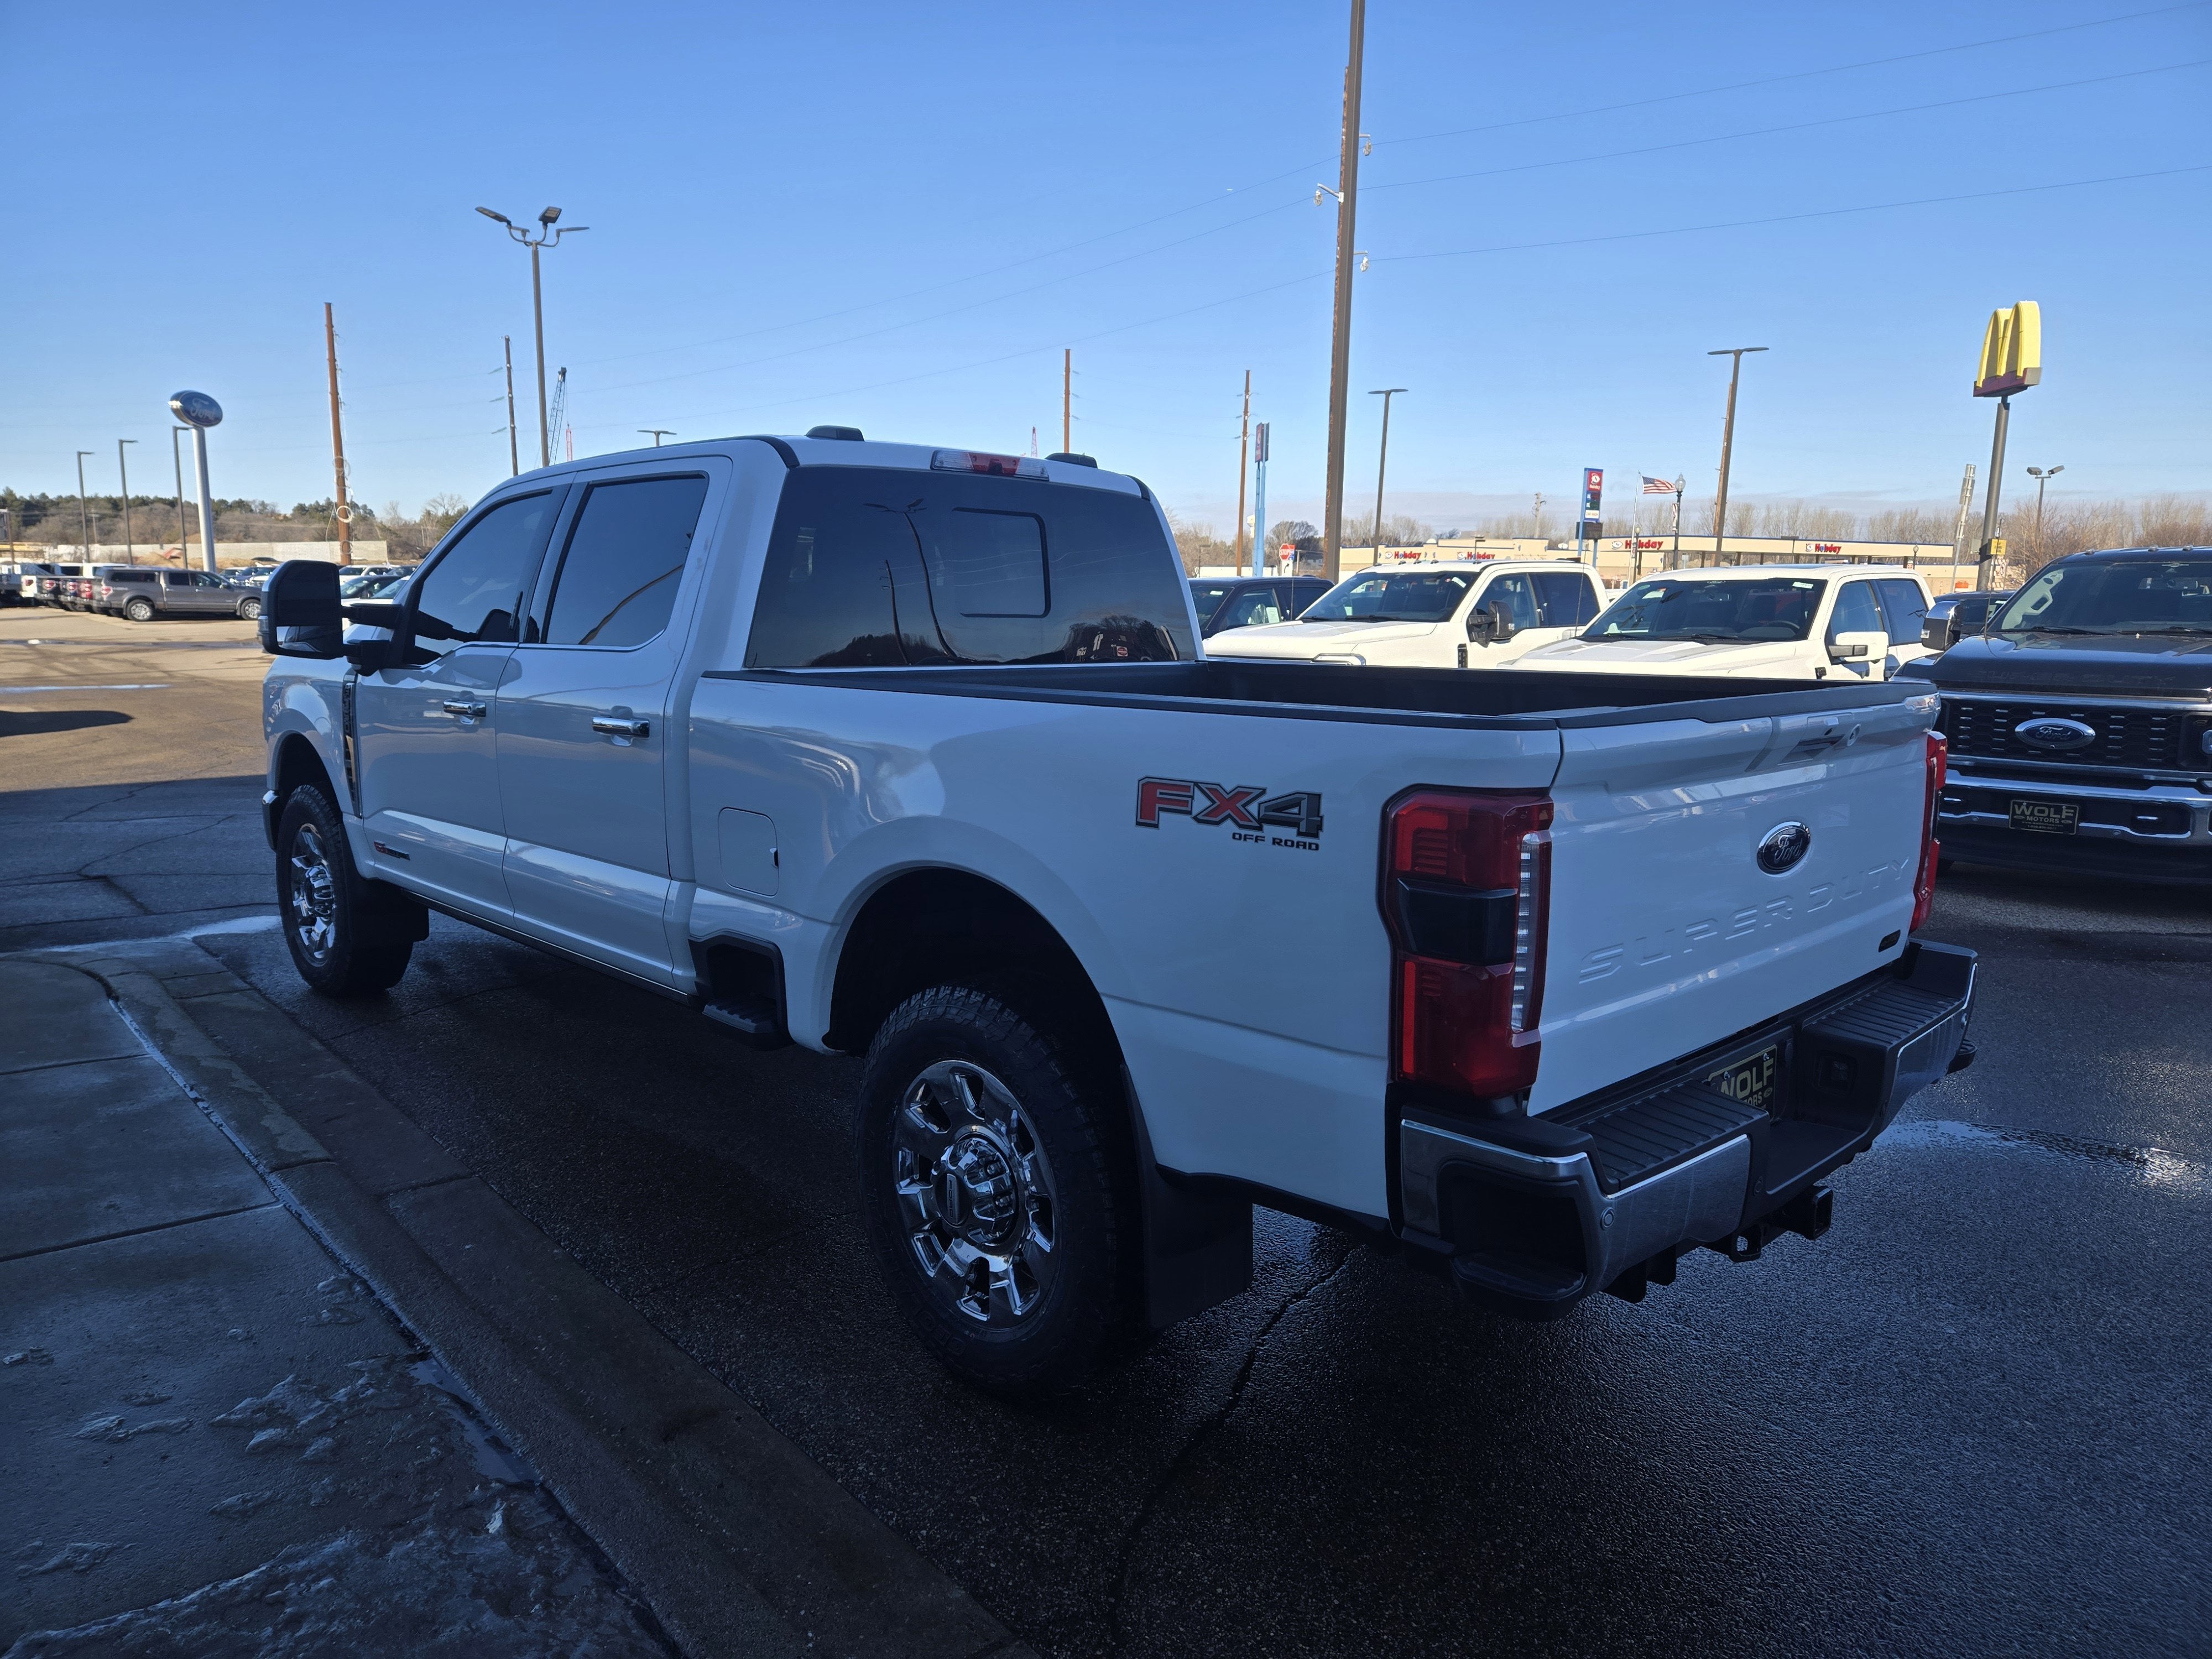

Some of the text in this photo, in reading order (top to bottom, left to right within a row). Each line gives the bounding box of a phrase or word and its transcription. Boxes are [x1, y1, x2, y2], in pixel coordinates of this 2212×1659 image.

[190, 398, 216, 420] Ford
[1625, 540, 1663, 550] Hliday
[1815, 544, 1841, 555] Holiday
[1394, 551, 1421, 561] Holiday
[2036, 726, 2072, 740] Ford
[1135, 775, 1324, 839] FX4
[2014, 804, 2074, 818] WOLF
[1232, 832, 1319, 851] OFF ROAD
[1774, 833, 1803, 863] Ford
[1578, 857, 1910, 984] SUPER DUTY
